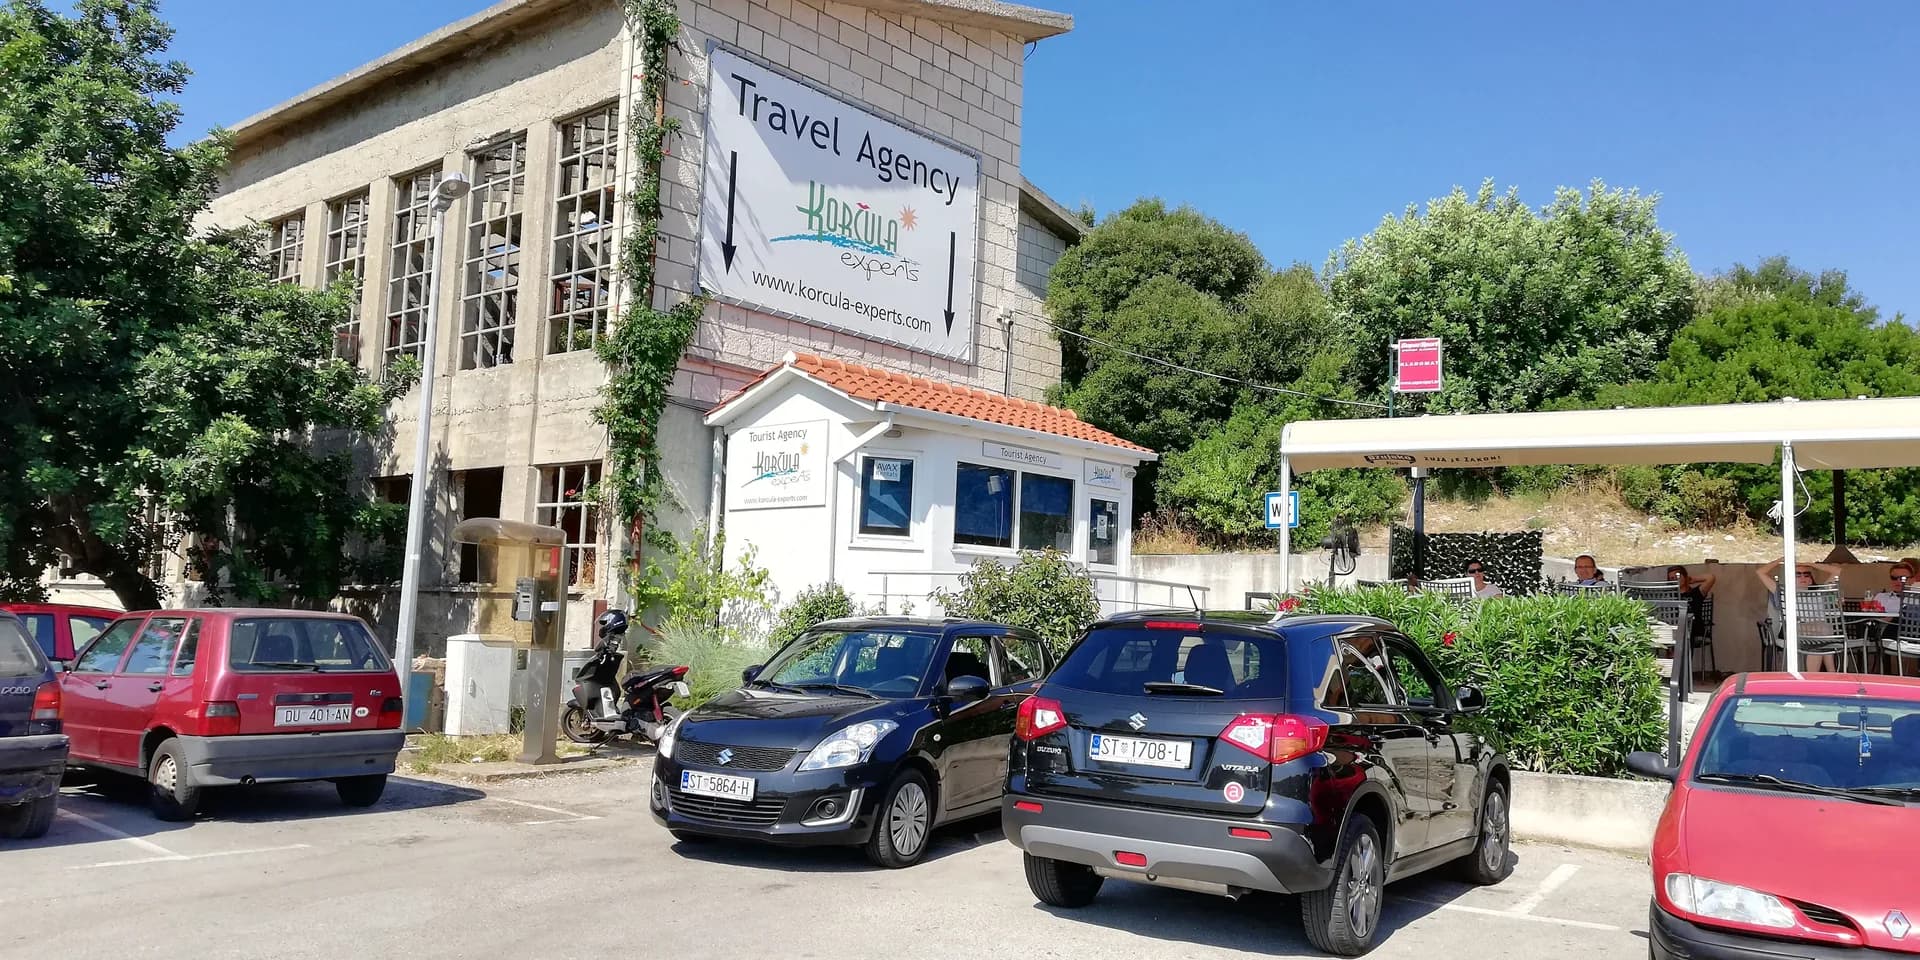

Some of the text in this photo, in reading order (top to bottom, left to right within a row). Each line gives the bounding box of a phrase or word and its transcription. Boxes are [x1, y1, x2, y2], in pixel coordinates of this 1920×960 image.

[731, 72, 960, 206] Travel Agency
[841, 252, 919, 281] experts
[752, 270, 931, 333] www.korcula-experts.com
[749, 429, 808, 443] Tourist Agency
[1001, 447, 1047, 465] Tourist Agency
[876, 463, 898, 472] AVAX
[285, 708, 350, 723] DU 401-AN
[1101, 738, 1182, 762] ST 1708-L
[1221, 764, 1259, 773] VITARA
[689, 774, 750, 795] ST 5864-H
